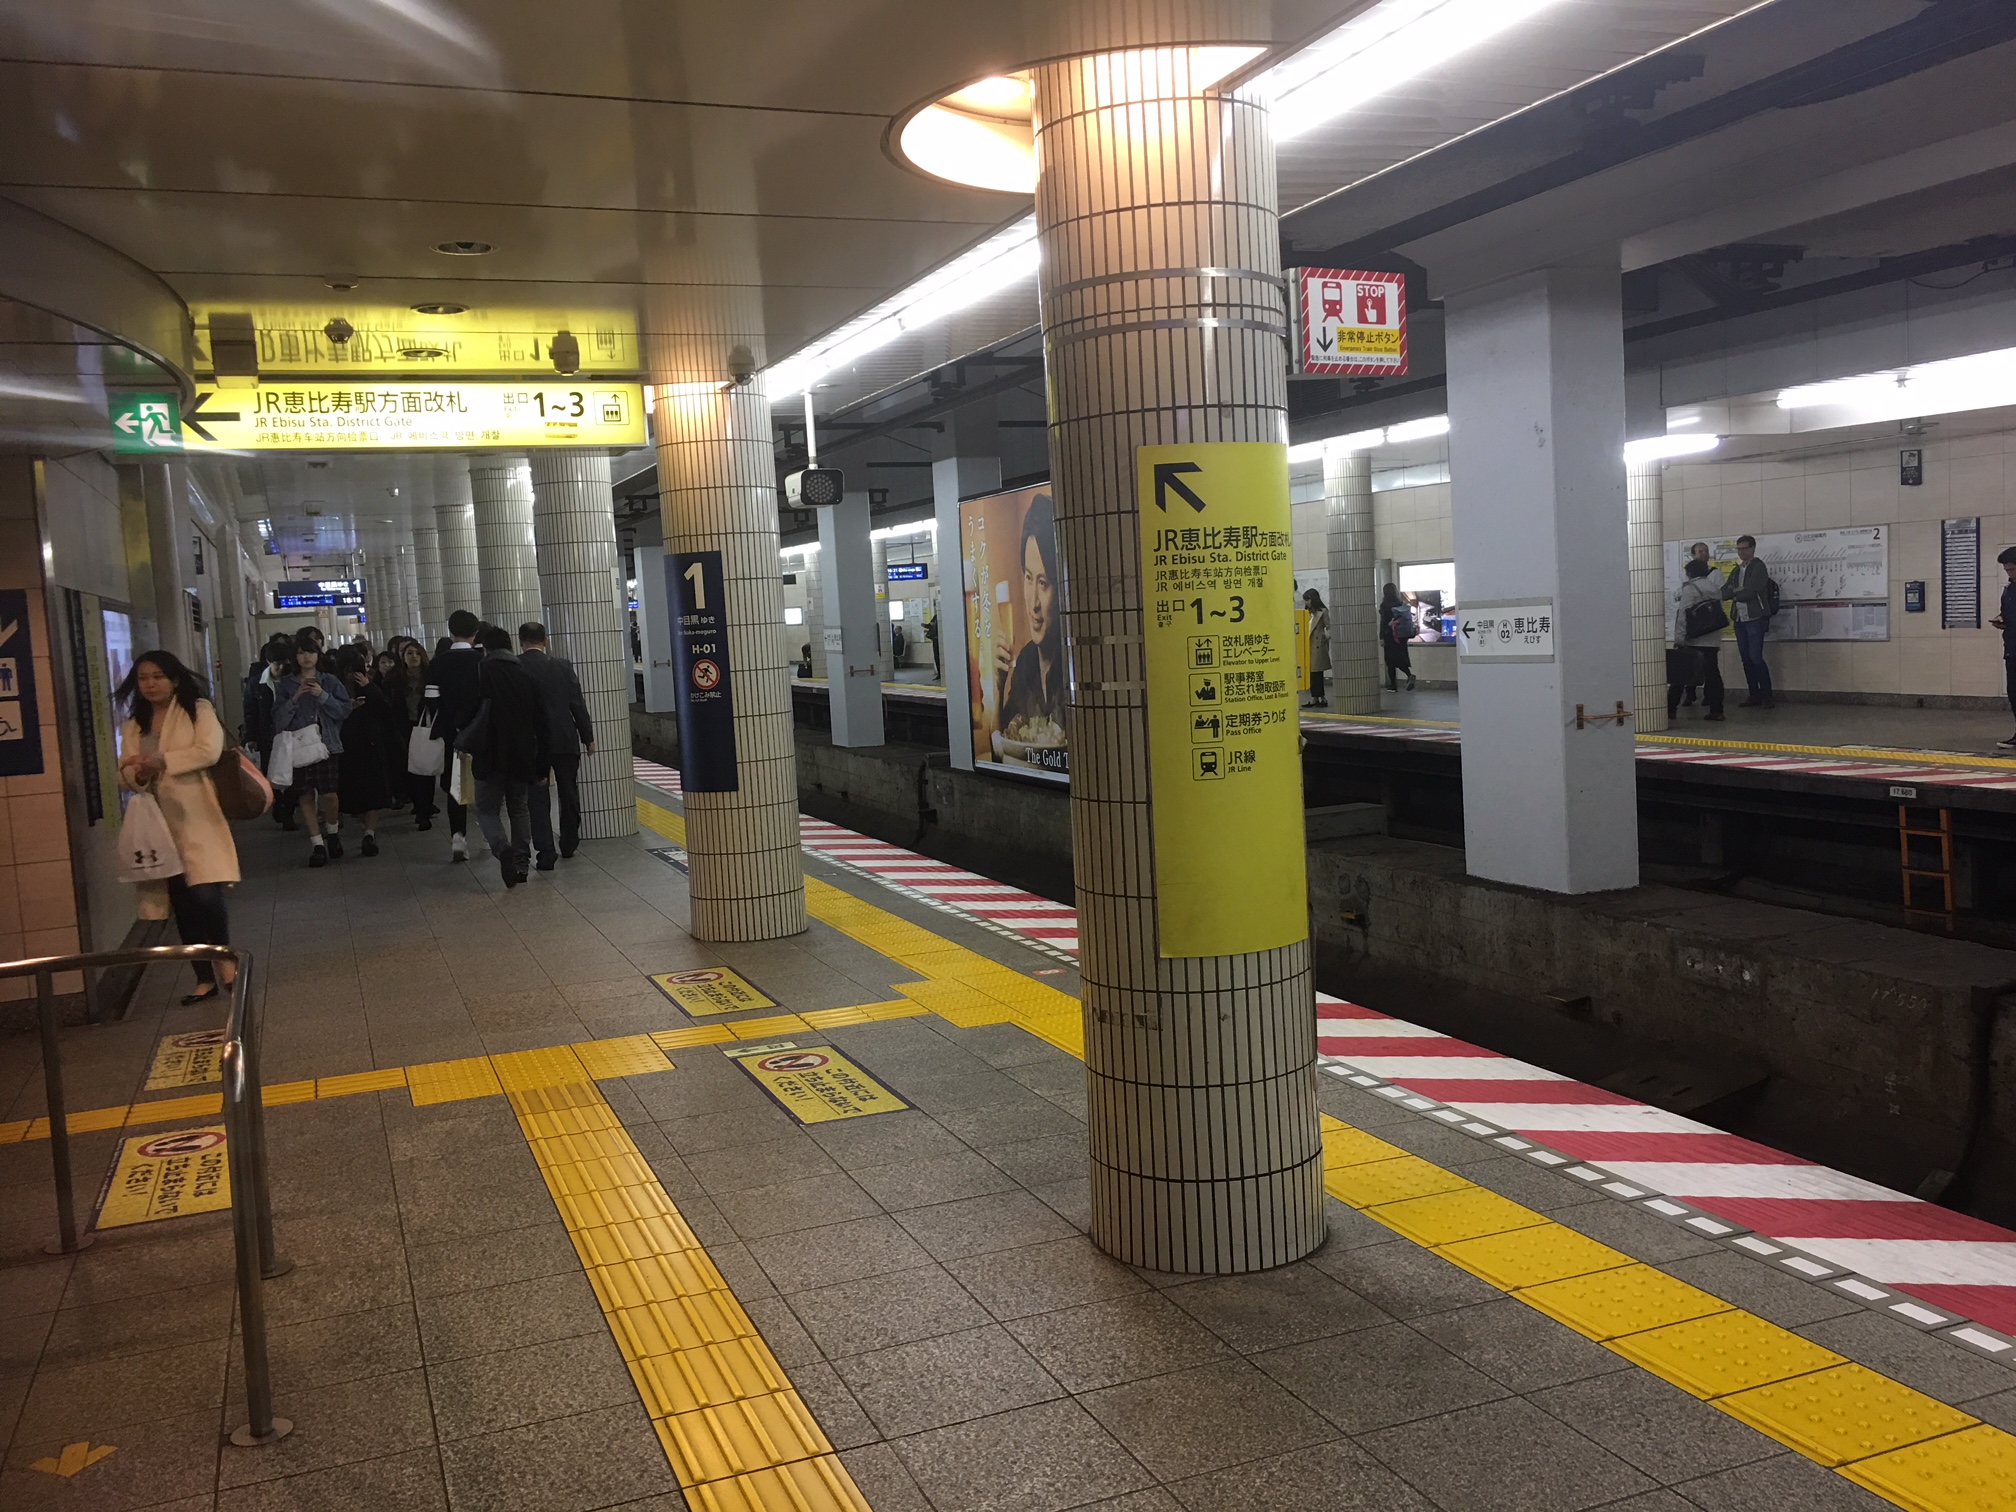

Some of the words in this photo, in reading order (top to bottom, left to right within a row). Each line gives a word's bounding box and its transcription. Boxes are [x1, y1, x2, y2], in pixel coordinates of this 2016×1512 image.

[1357, 285, 1385, 297] STOP
[1337, 330, 1399, 344] 非常停止ボタン
[253, 390, 468, 414] JR恵比寿駅方面改札
[503, 392, 528, 404] 出口
[255, 417, 268, 428] JR
[272, 416, 305, 428] Ebisu
[310, 416, 333, 427] Sta.
[337, 416, 380, 428] District
[384, 417, 413, 427] Gate
[1153, 526, 1292, 553] JR恵比寿駅方面改札
[1873, 527, 1880, 540] 2
[1154, 554, 1168, 566] JR
[1171, 553, 1206, 565] Ebisu
[1210, 552, 1232, 563] Sta.
[1236, 550, 1270, 562] District
[1271, 550, 1287, 561] Gate
[352, 579, 361, 593] 1
[683, 562, 706, 609] 1
[1155, 582, 1168, 592] JR
[1173, 580, 1217, 592] 에비스역
[1223, 579, 1242, 590] 방면
[1248, 577, 1264, 588] 개찰
[1156, 600, 1185, 613] 出口
[1190, 595, 1245, 625] 1~3
[1514, 616, 1551, 634] 恵比寿
[1223, 634, 1270, 647] 改札階ゆき
[1500, 630, 1510, 639] 02
[1524, 635, 1541, 644] えびす
[692, 643, 716, 654] H-01
[1223, 646, 1275, 659] エレベーター
[1224, 671, 1265, 684] 駅事務室
[1224, 680, 1286, 696] お忘れ物取扱所
[1225, 709, 1286, 728] 定期券うりば
[1025, 747, 1041, 765] The
[1043, 749, 1061, 767] Gold
[1228, 749, 1256, 765] JR線
[799, 1071, 863, 1114] 立ち止まらないで
[826, 1068, 878, 1102] この付近には
